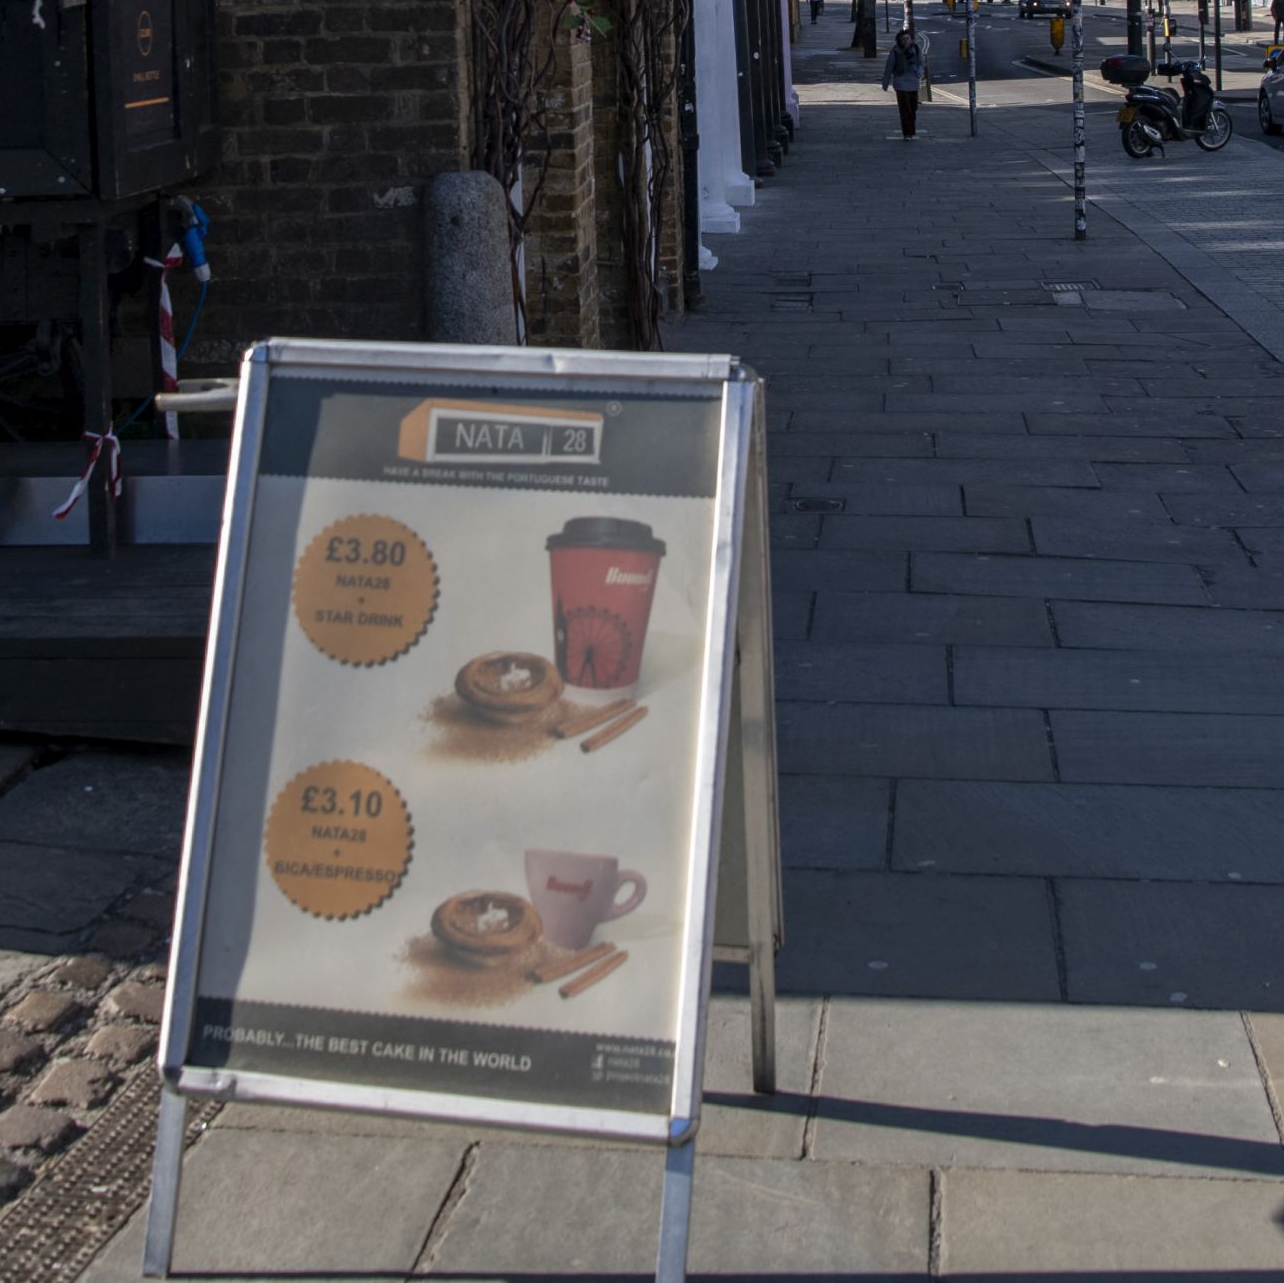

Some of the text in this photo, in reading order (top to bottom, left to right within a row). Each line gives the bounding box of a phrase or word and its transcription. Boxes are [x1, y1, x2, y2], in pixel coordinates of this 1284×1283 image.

[455, 423, 587, 453] NATA 28
[383, 466, 610, 487] HAVE A BREAK WITH THE PORTUGUESE TASTE
[326, 536, 406, 567] £3.80
[335, 574, 391, 590] NATA28
[316, 609, 404, 628] STAR DRINK
[302, 785, 383, 818] £3.10
[312, 825, 367, 843] NATA28
[327, 1036, 368, 1055] BEST
[371, 1041, 415, 1060] CAKE
[418, 1046, 435, 1062] IN
[437, 1048, 469, 1065] THE
[472, 1051, 532, 1072] WORLD
